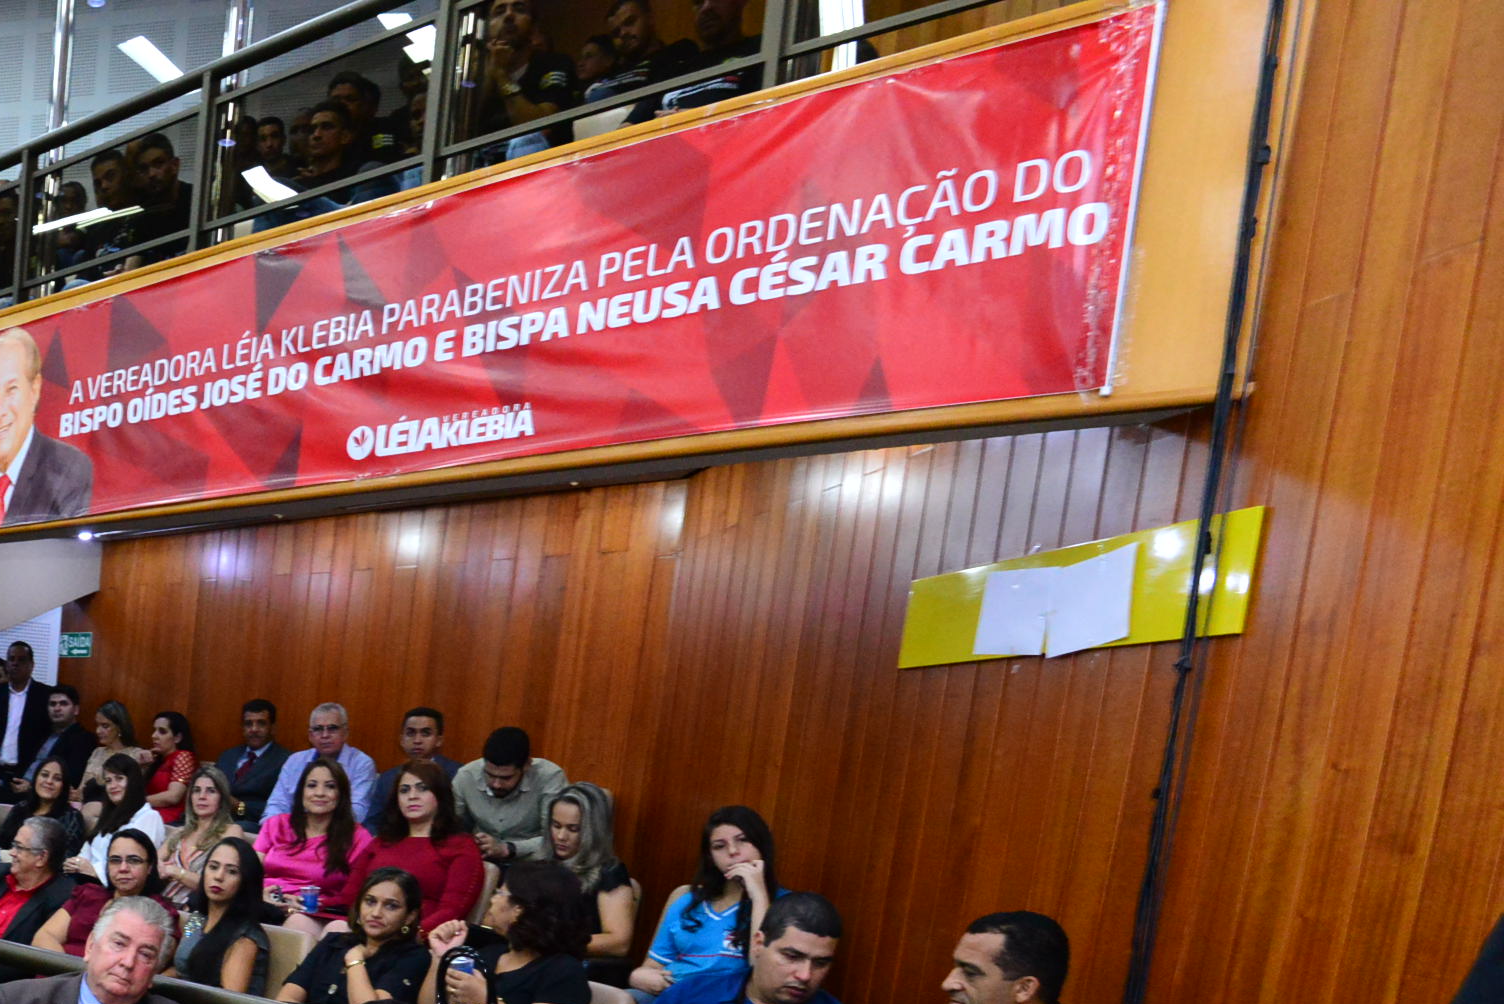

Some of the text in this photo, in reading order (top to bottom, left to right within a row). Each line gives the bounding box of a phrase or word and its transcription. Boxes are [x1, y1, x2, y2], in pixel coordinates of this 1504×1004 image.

[59, 202, 1110, 438] BISPO OÍDES JOSÉ DO CARMO E BISPA NEUSA CÉSAR CARMO
[69, 149, 1092, 405] A VEREADORA LÉIA KLEBIA PARABENIZA PELA ORDENAÇÃO DO
[442, 402, 532, 422] VEREADORA
